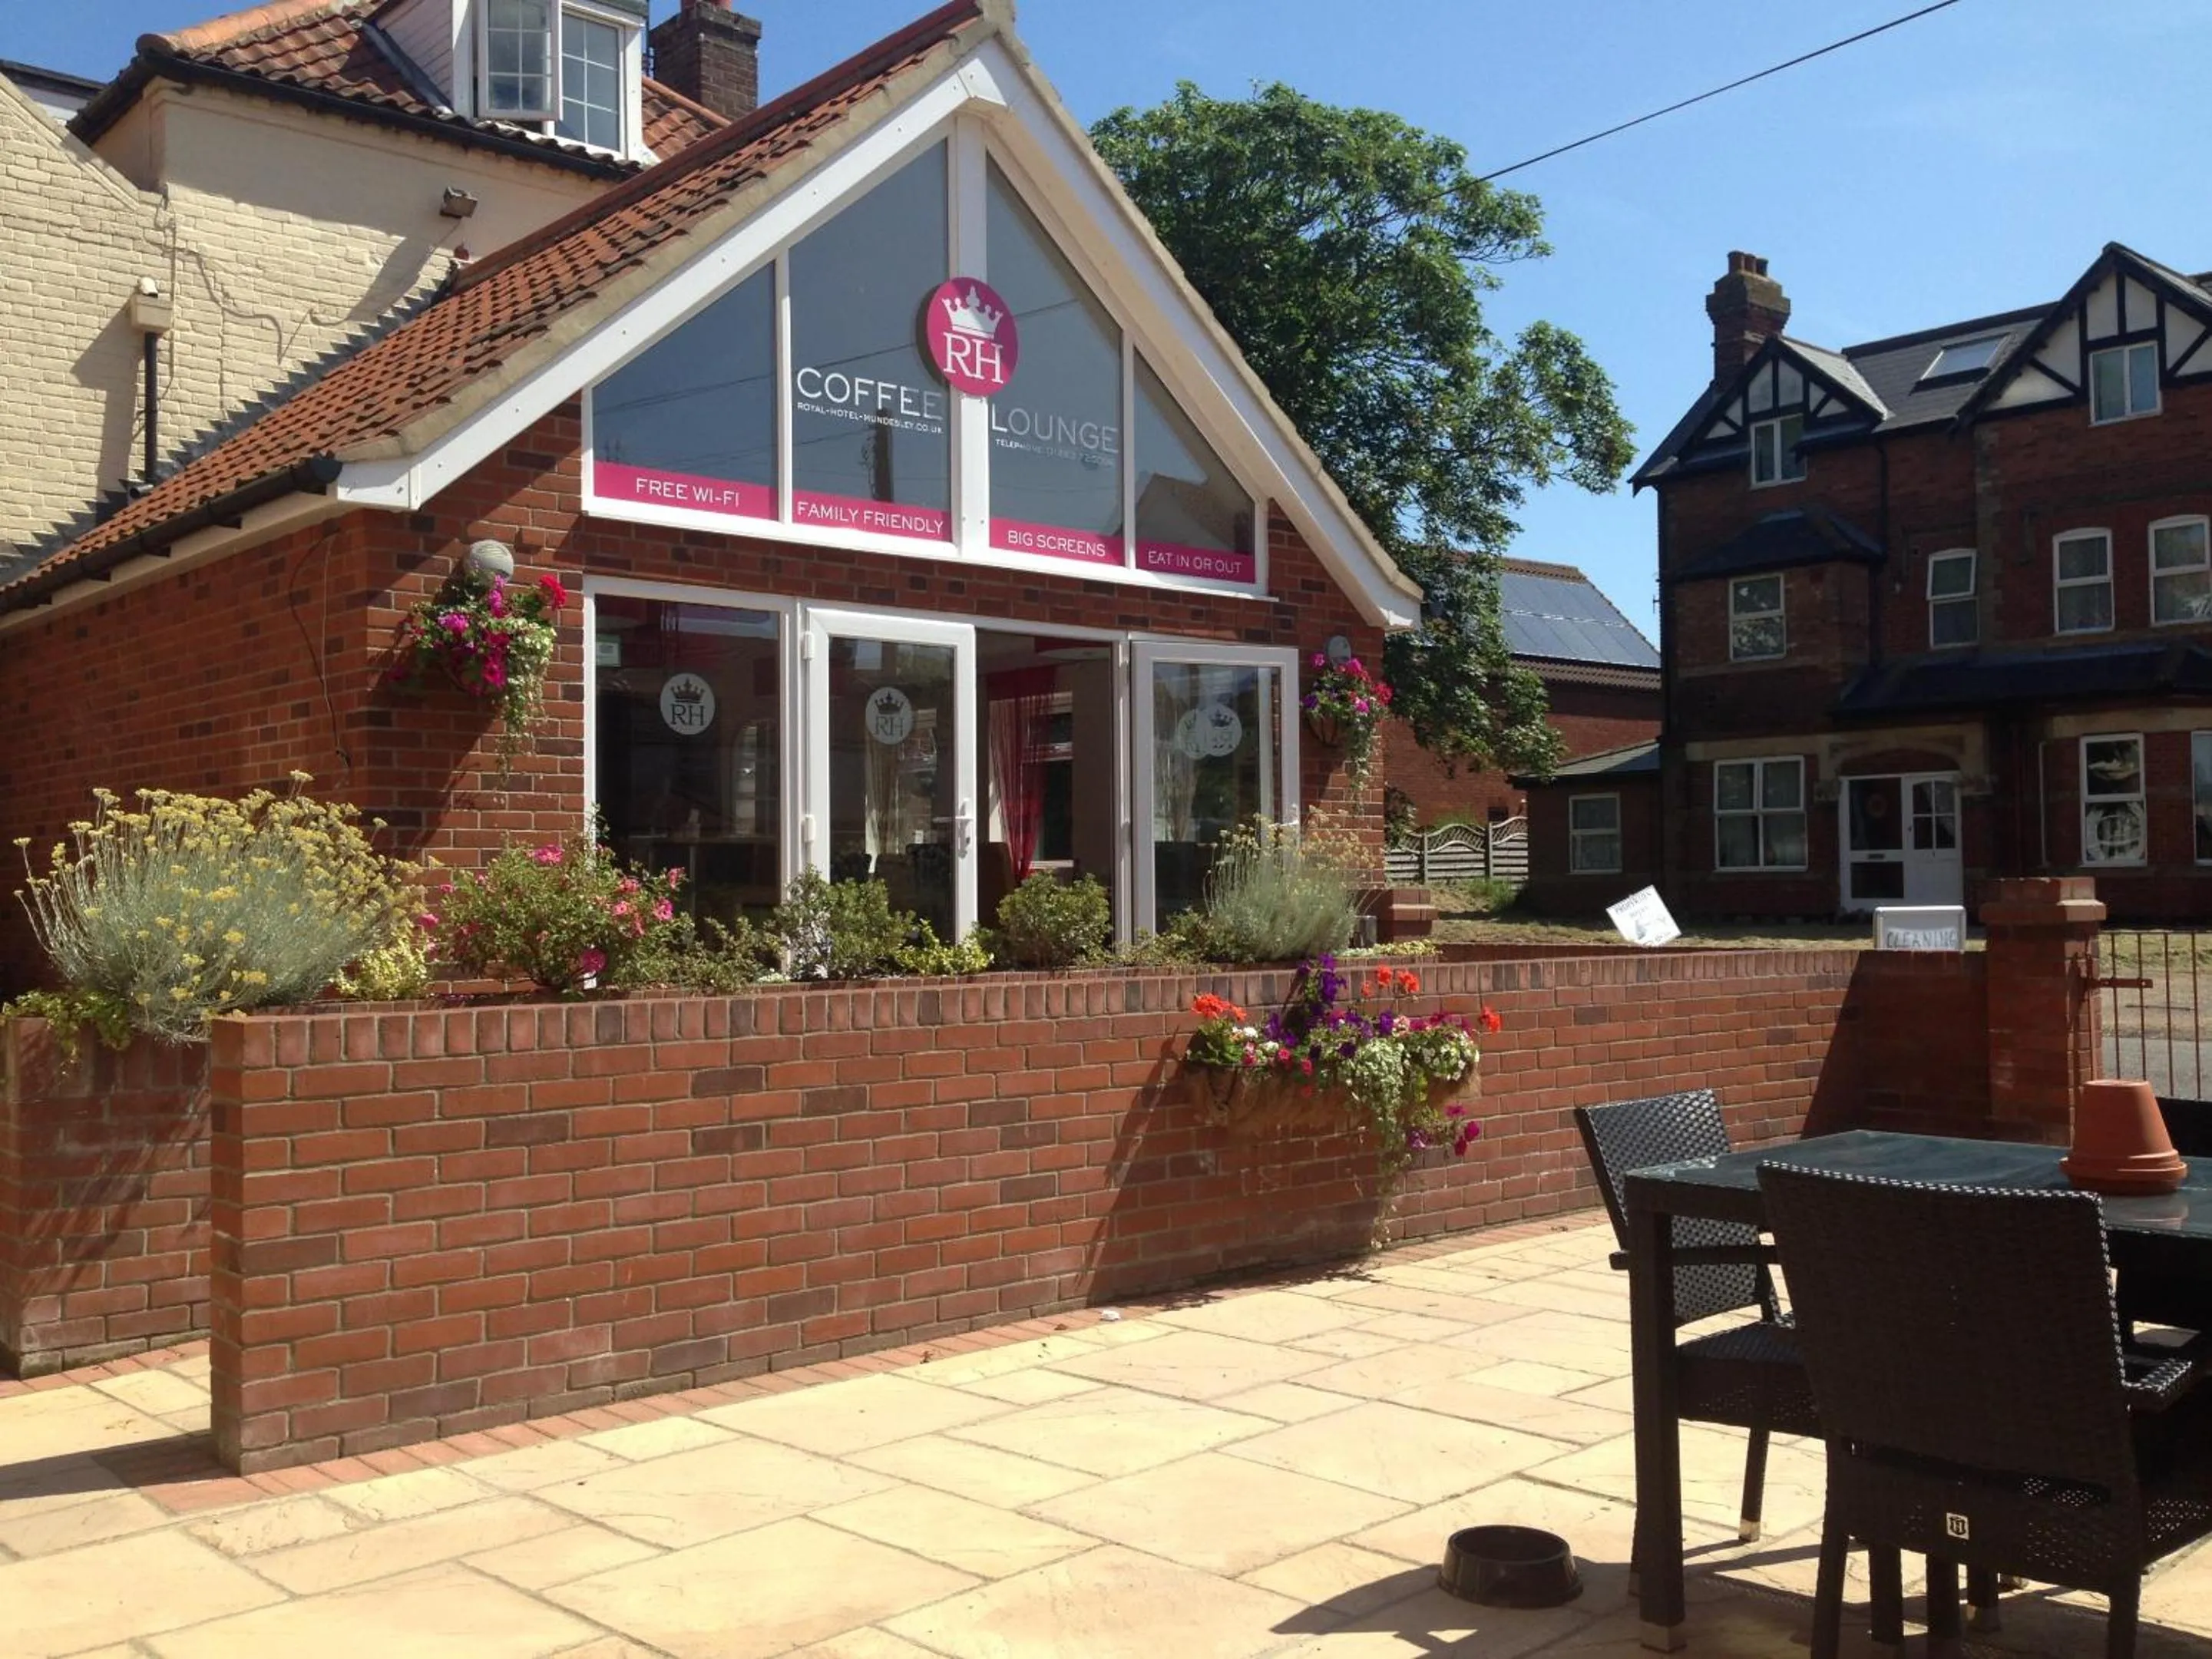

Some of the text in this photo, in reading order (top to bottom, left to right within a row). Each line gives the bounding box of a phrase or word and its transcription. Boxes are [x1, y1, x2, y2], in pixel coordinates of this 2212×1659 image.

[943, 332, 1004, 384] RH
[797, 367, 1119, 454] COFFEE LOUNGE
[636, 478, 740, 507] FREE WI-FI
[797, 501, 944, 535] FAMILY FRIENDLY
[1007, 530, 1106, 557] BIG SCREENS
[1148, 550, 1243, 574] EAT IN OR OUT
[670, 702, 706, 726] RH
[875, 715, 904, 738] RH
[1886, 928, 1958, 949] CLEANING
